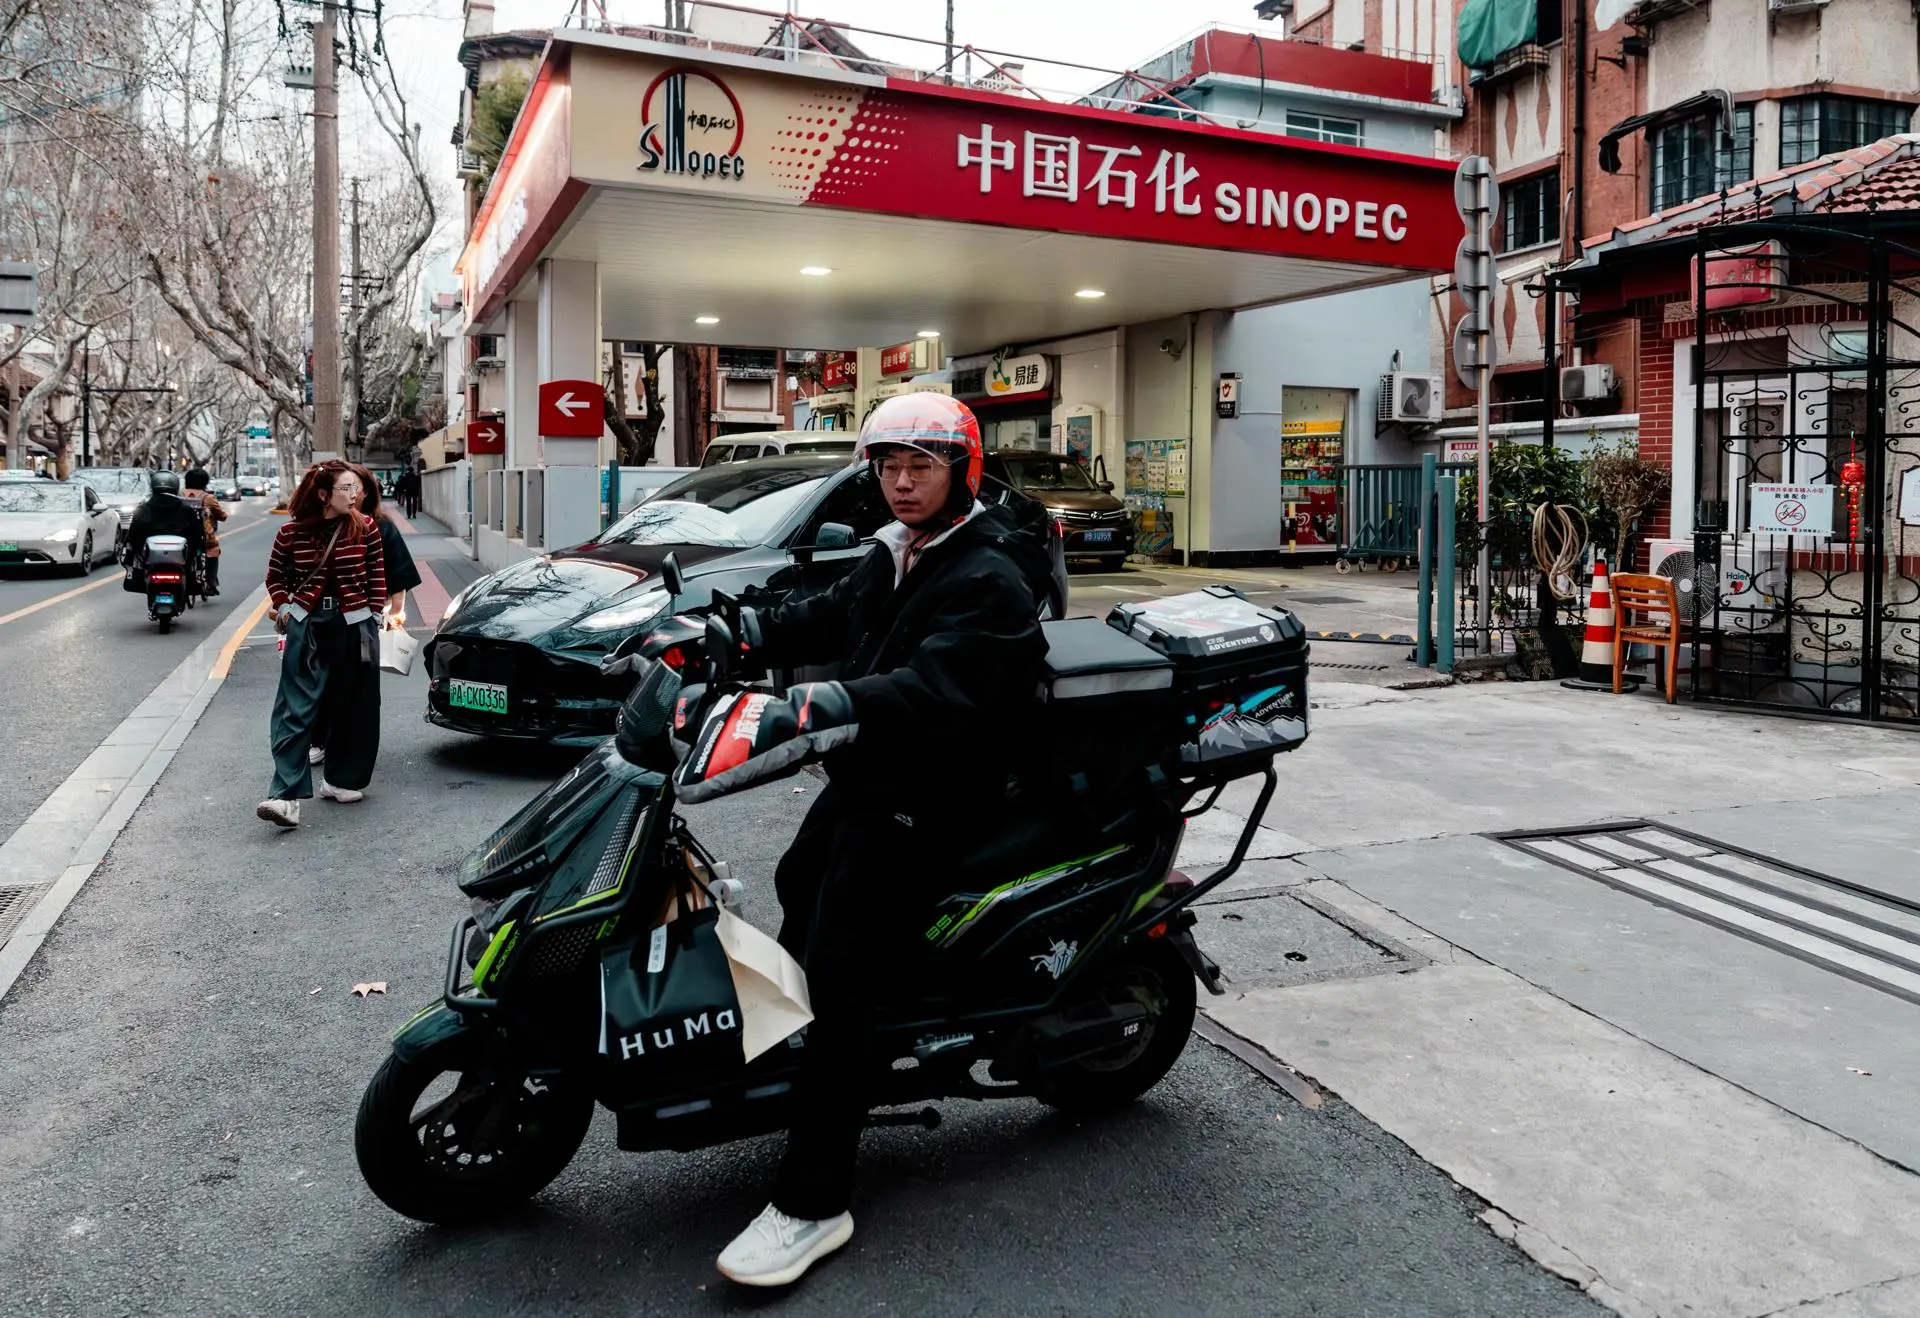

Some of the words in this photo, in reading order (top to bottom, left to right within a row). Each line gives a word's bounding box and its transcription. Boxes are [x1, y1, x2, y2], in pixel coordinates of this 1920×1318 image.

[687, 110, 735, 133] 中国石化
[957, 123, 1201, 216] 中国石化
[1214, 182, 1407, 241] SINOPEC
[844, 361, 857, 375] 98
[1015, 364, 1038, 386] 易捷
[1208, 636, 1259, 651] ADVENTURE
[1254, 690, 1296, 719] ADVENTURE
